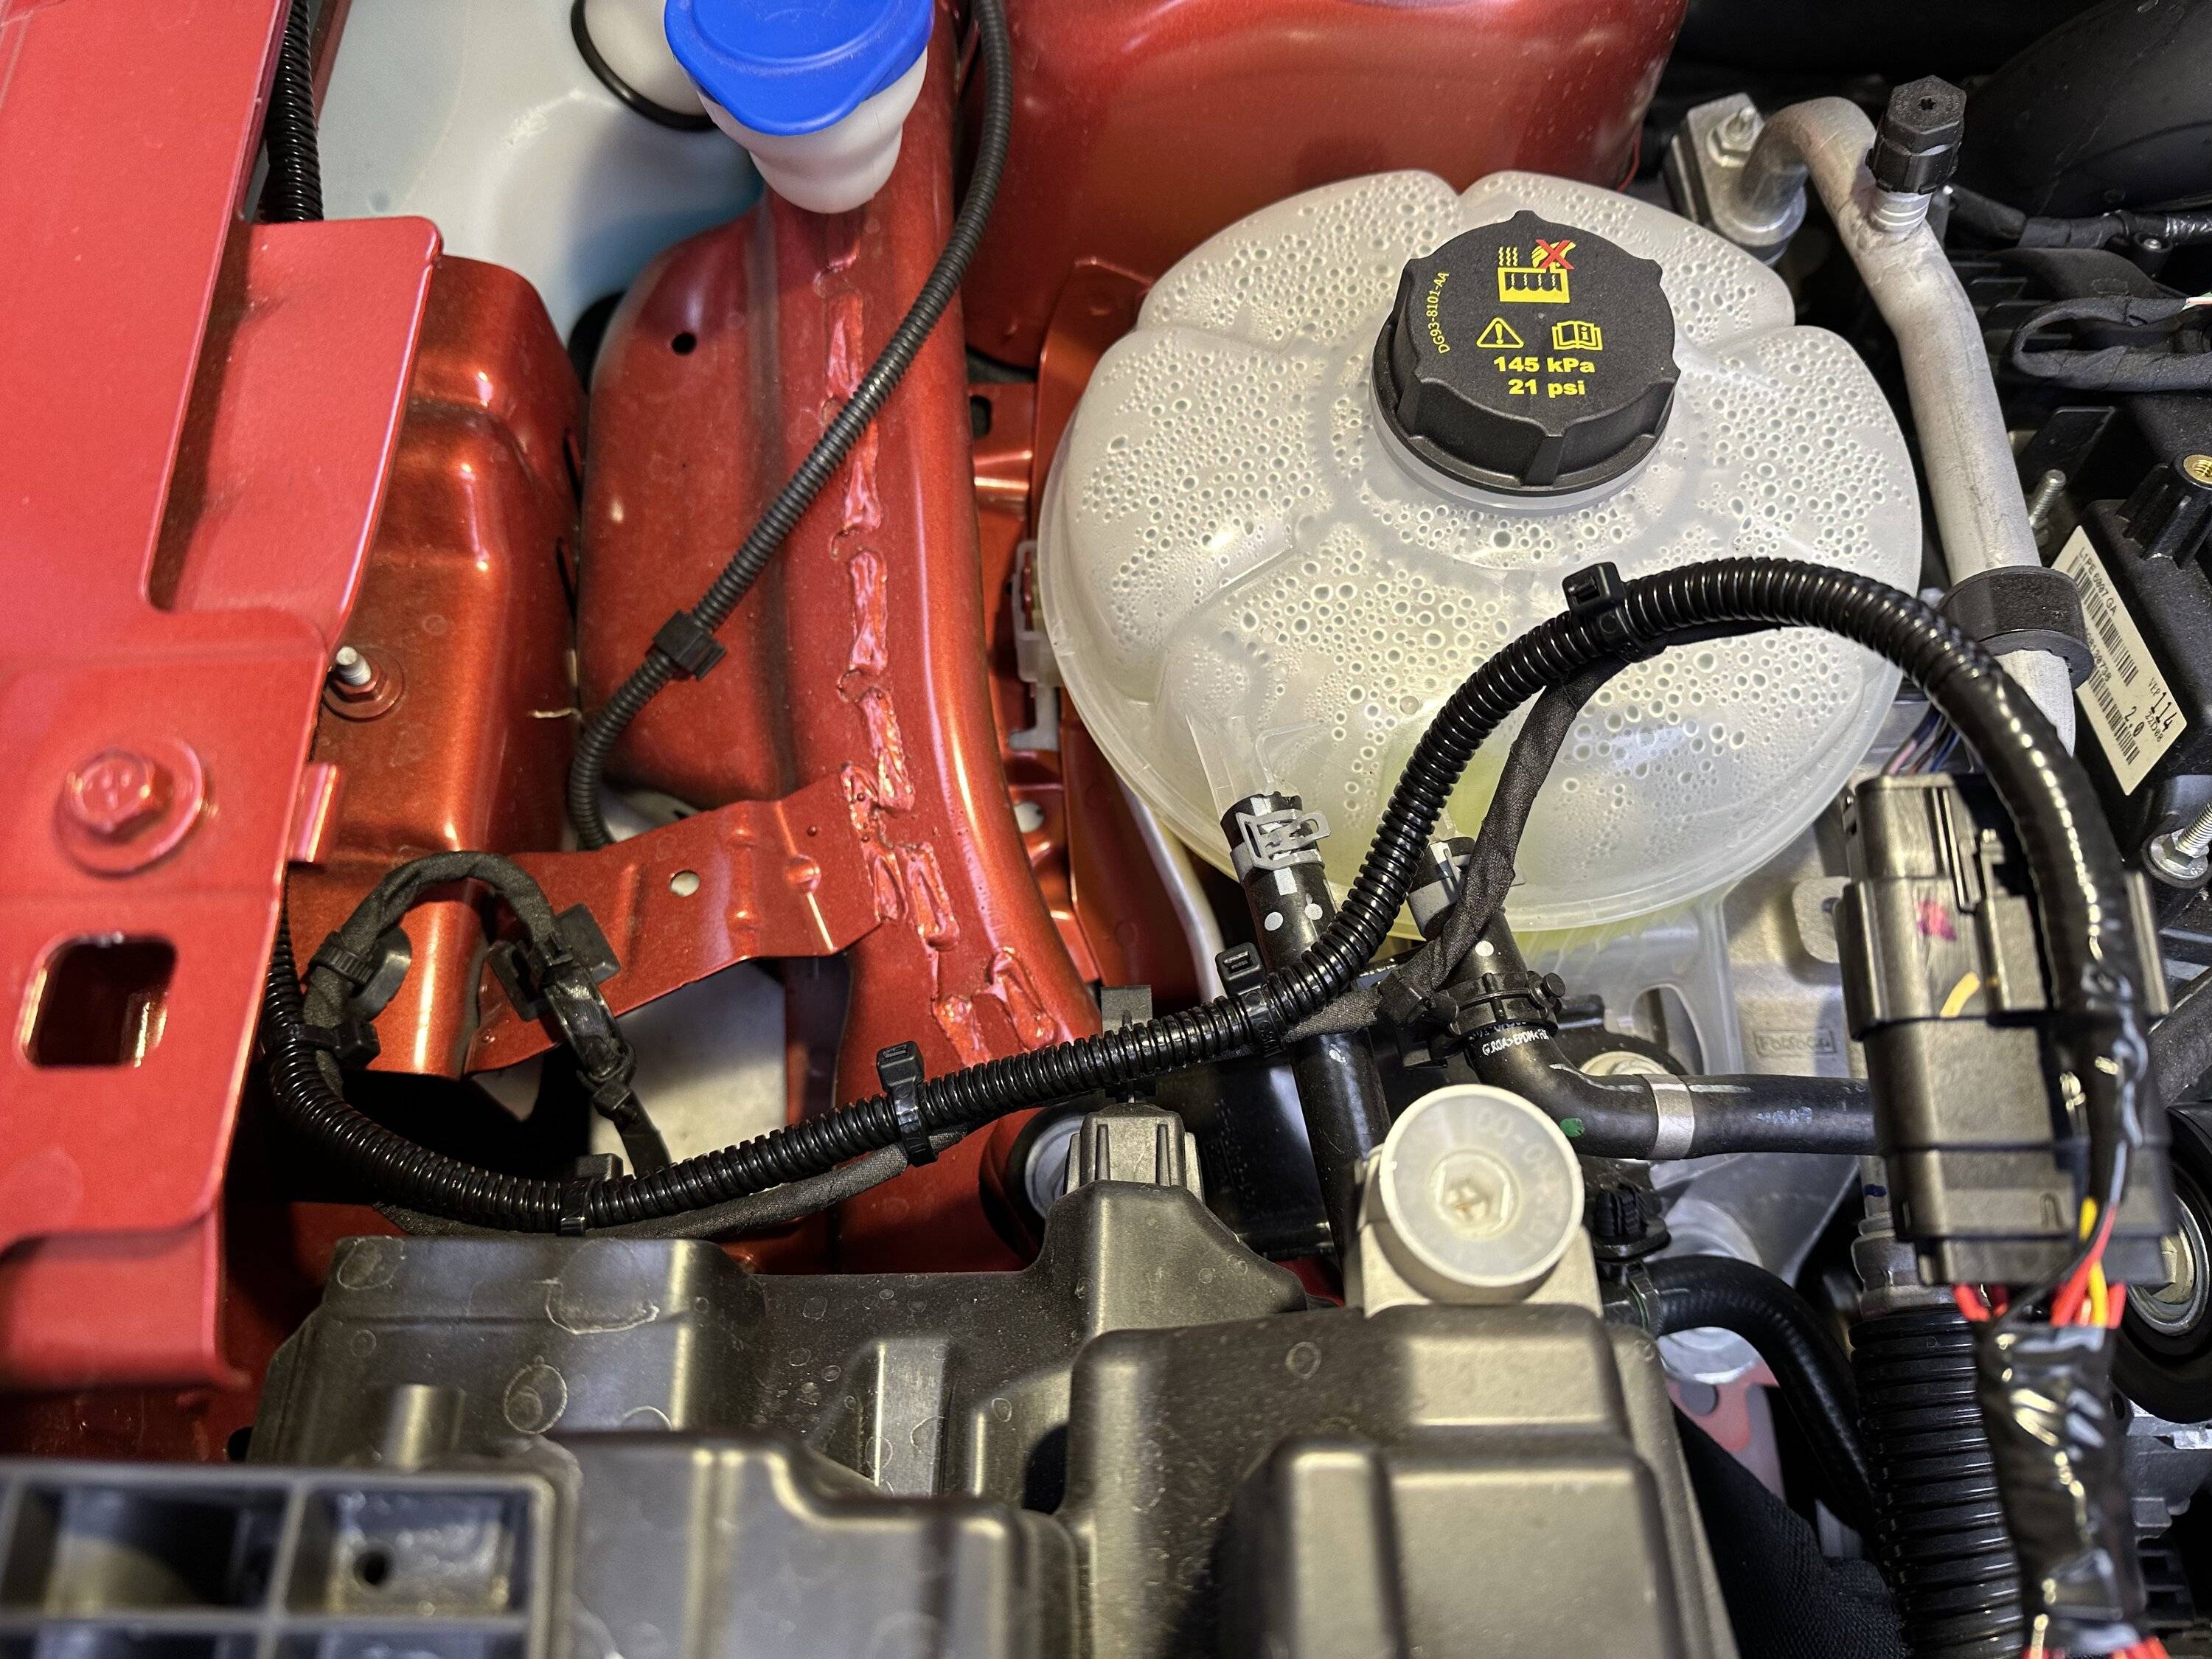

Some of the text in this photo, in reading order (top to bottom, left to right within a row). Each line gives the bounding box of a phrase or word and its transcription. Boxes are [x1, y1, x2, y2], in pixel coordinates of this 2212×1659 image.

[1426, 271, 1451, 354] DG93-8101-AA
[1493, 356, 1595, 372] 145 kPa
[1508, 378, 1585, 398] 21 psi
[2106, 597, 2117, 616] GA
[2124, 706, 2145, 737] 2.0
[2150, 692, 2177, 733] 114
